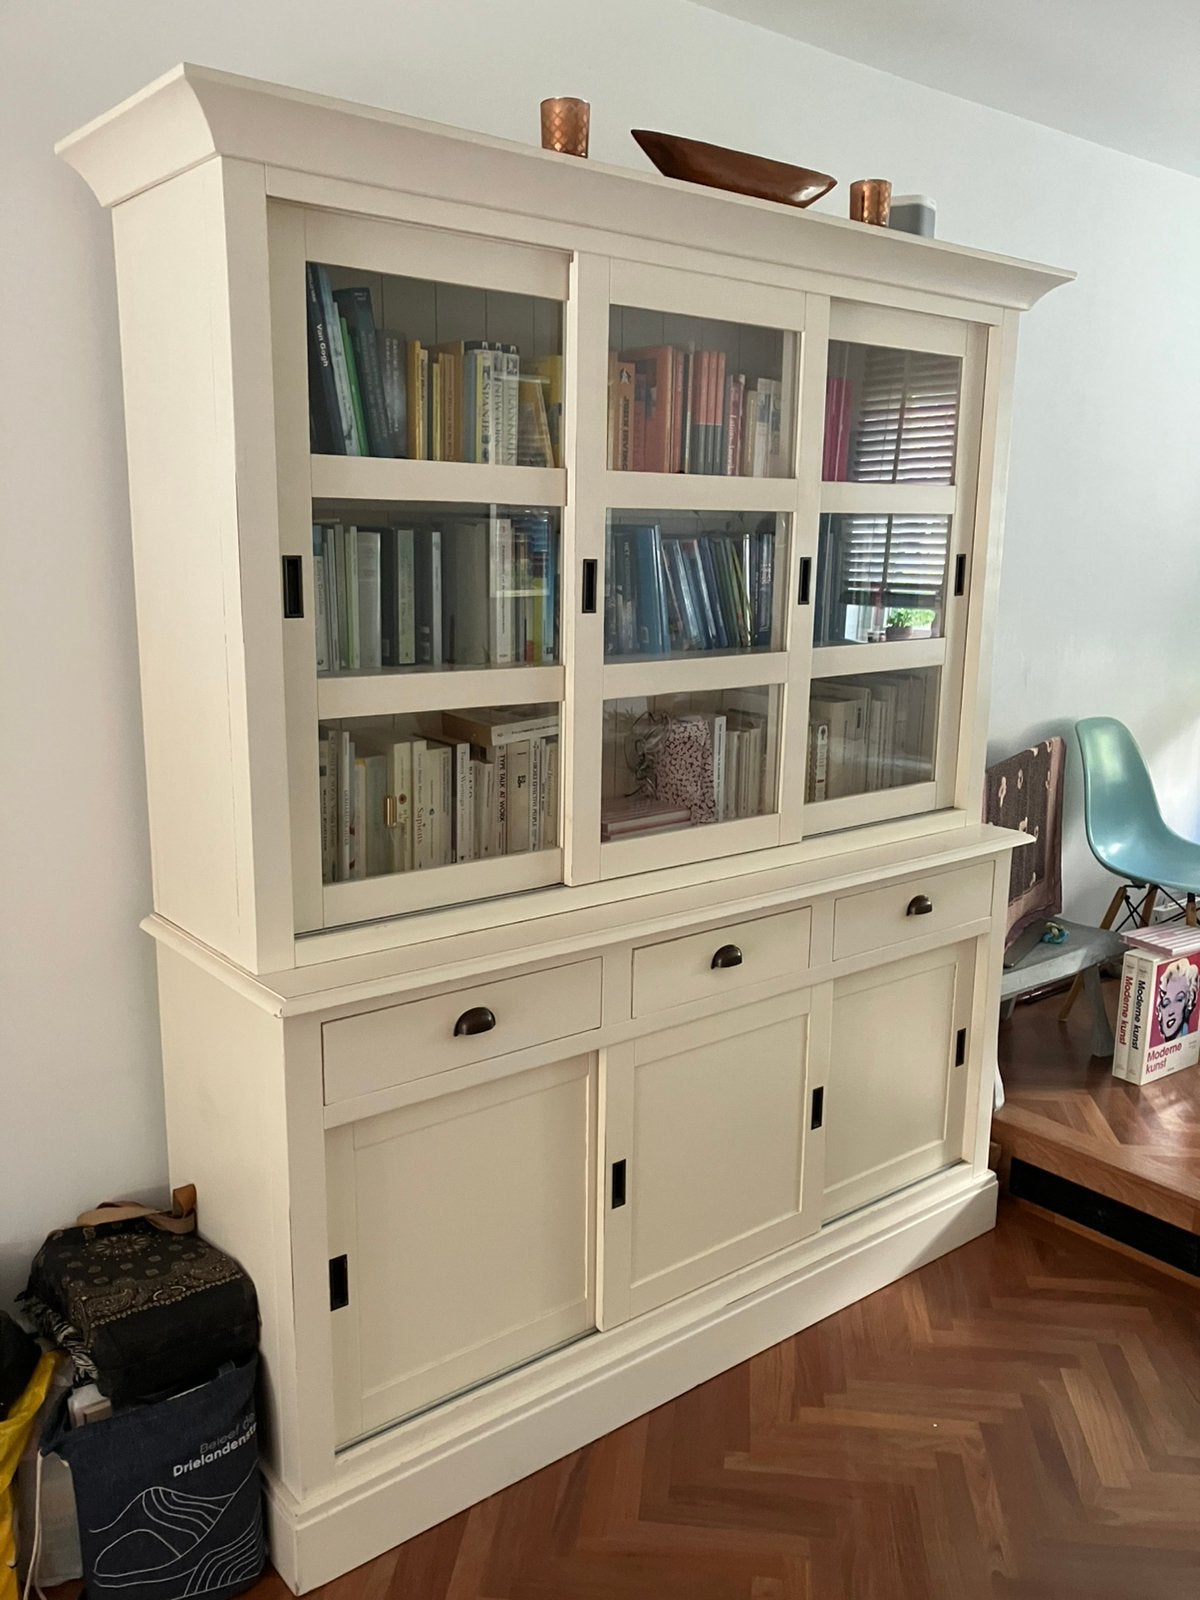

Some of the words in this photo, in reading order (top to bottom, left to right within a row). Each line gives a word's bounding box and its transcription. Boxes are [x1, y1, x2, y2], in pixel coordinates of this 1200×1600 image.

[316, 323, 325, 343] Van
[319, 343, 329, 367] Gogh
[482, 382, 490, 433] SPANJE
[416, 806, 426, 845] Sapiens
[1122, 976, 1133, 1018] Moderne
[1134, 980, 1146, 1022] Moderne
[1119, 1020, 1129, 1046] kunst
[1131, 1023, 1142, 1050] kunst
[1147, 1042, 1182, 1062] Moderne
[1146, 1057, 1167, 1075] kunst
[201, 1423, 239, 1454] Beleef
